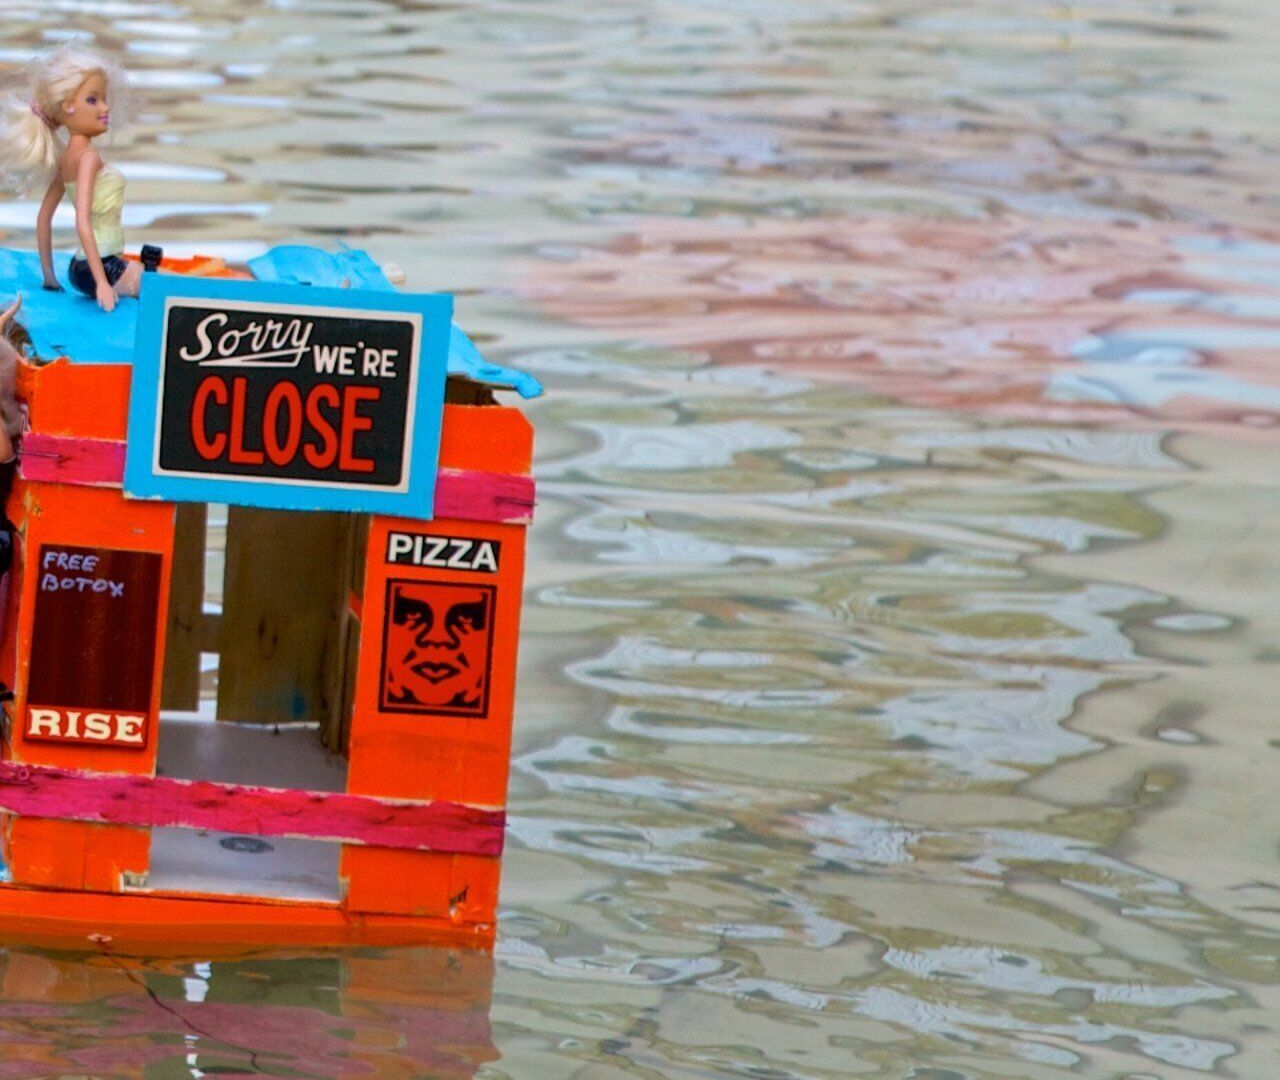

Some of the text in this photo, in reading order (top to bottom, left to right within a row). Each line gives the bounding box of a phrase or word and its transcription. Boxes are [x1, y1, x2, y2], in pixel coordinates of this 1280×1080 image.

[179, 312, 399, 378] Sorry WE'RE
[191, 375, 382, 473] CLOSE
[43, 551, 100, 573] FREE
[387, 532, 499, 573] PIZZA
[41, 573, 125, 598] BOTOX
[27, 708, 145, 744] RISE
